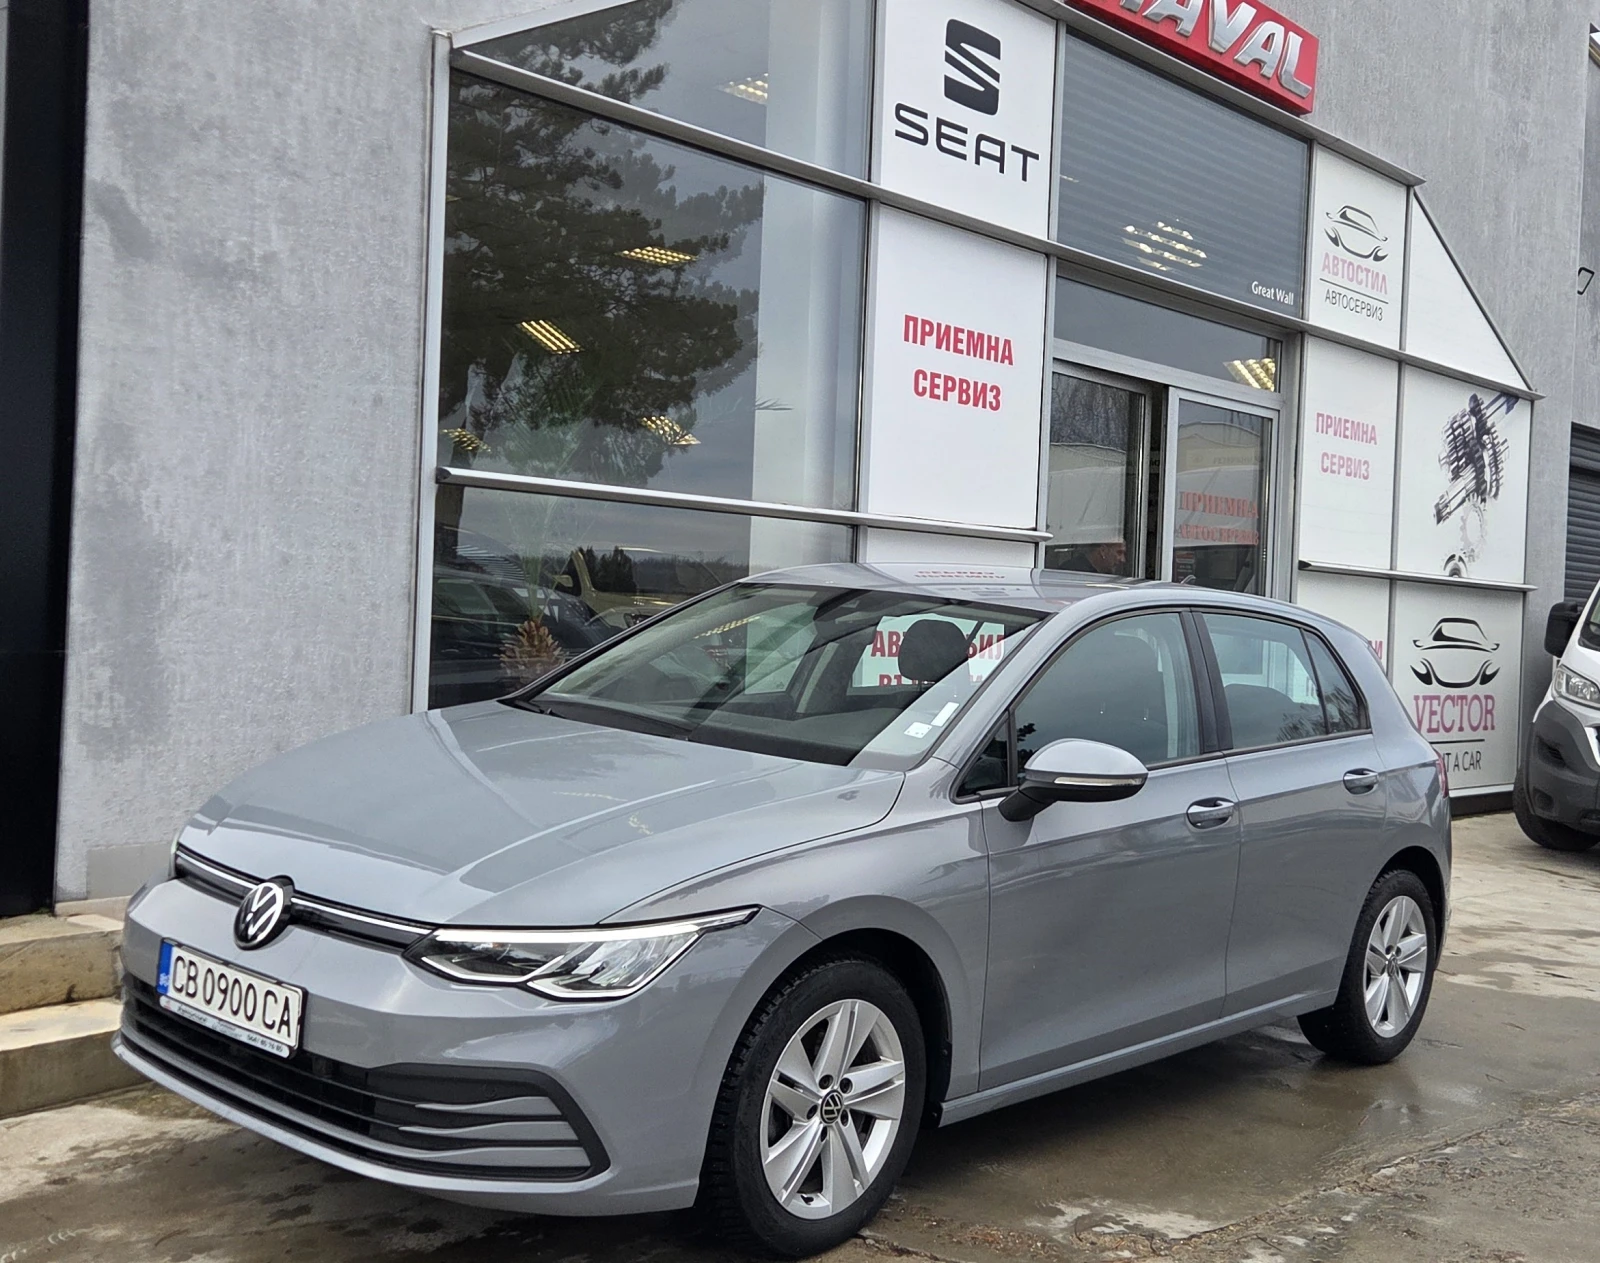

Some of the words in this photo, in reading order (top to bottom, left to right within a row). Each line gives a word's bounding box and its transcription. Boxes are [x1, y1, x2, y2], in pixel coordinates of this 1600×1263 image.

[1119, 0, 1313, 99] AVAL
[894, 102, 1040, 183] SEAT
[1251, 280, 1275, 300] Great
[1276, 287, 1294, 306] Wall
[1321, 251, 1388, 295] АВТОСТИЛ
[1324, 288, 1384, 322] АВТОСЕРВИЗ
[903, 313, 1014, 366] ПРИЕМНА
[913, 368, 1001, 412] СЕРВИЗ
[1315, 412, 1378, 446] ПРИЕМНА
[1321, 451, 1370, 480] СЕРВИЗ
[1413, 693, 1496, 734] VECTOR
[1462, 750, 1482, 772] CAR
